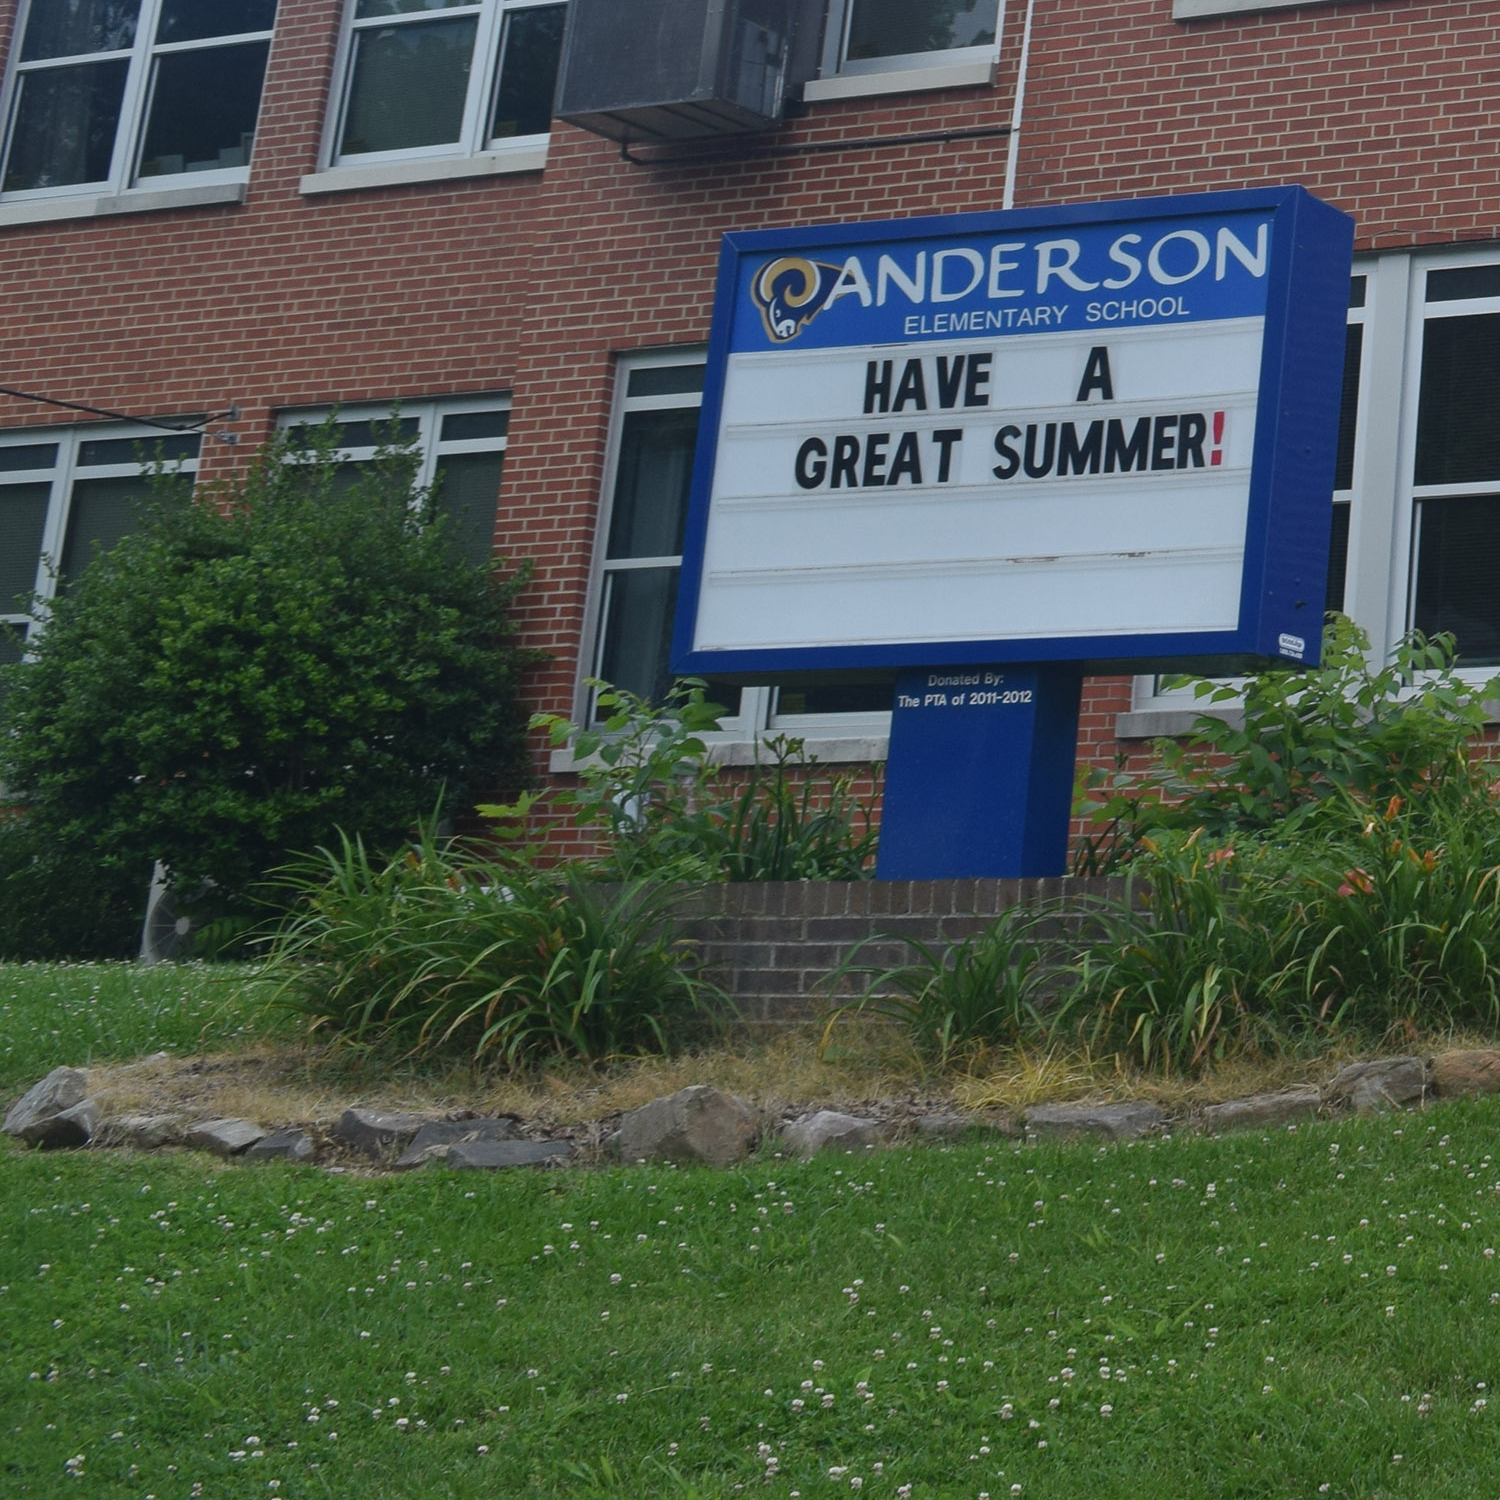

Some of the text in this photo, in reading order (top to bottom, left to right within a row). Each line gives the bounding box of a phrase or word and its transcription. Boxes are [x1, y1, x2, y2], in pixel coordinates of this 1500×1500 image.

[823, 222, 1268, 311] ANDERSON
[904, 296, 1190, 335] ELEMENTARY SCHOOL
[863, 346, 1115, 414] HAVE A
[795, 411, 1225, 490] GREAT SUMMER!
[898, 690, 1033, 708] The PTA of 2011-2012
[927, 672, 1005, 687] Donated By:
